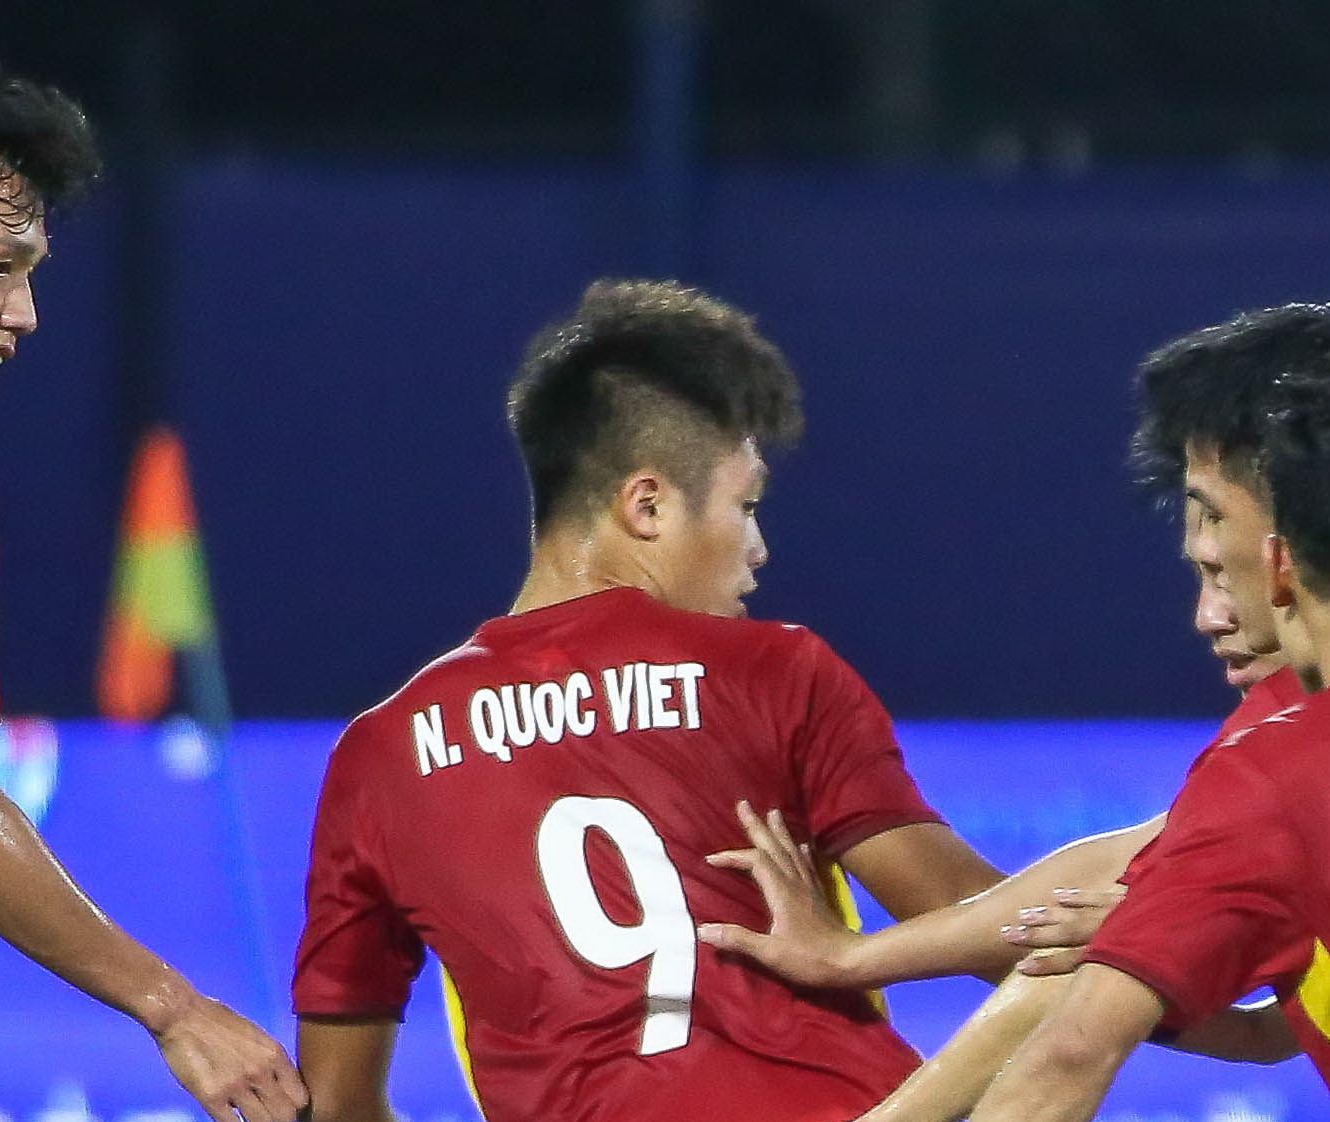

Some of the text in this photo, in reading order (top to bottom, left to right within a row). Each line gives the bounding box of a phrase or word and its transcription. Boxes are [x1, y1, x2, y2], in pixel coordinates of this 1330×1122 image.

[412, 661, 706, 778] N. QUOC VIET
[534, 793, 697, 1057] 9
